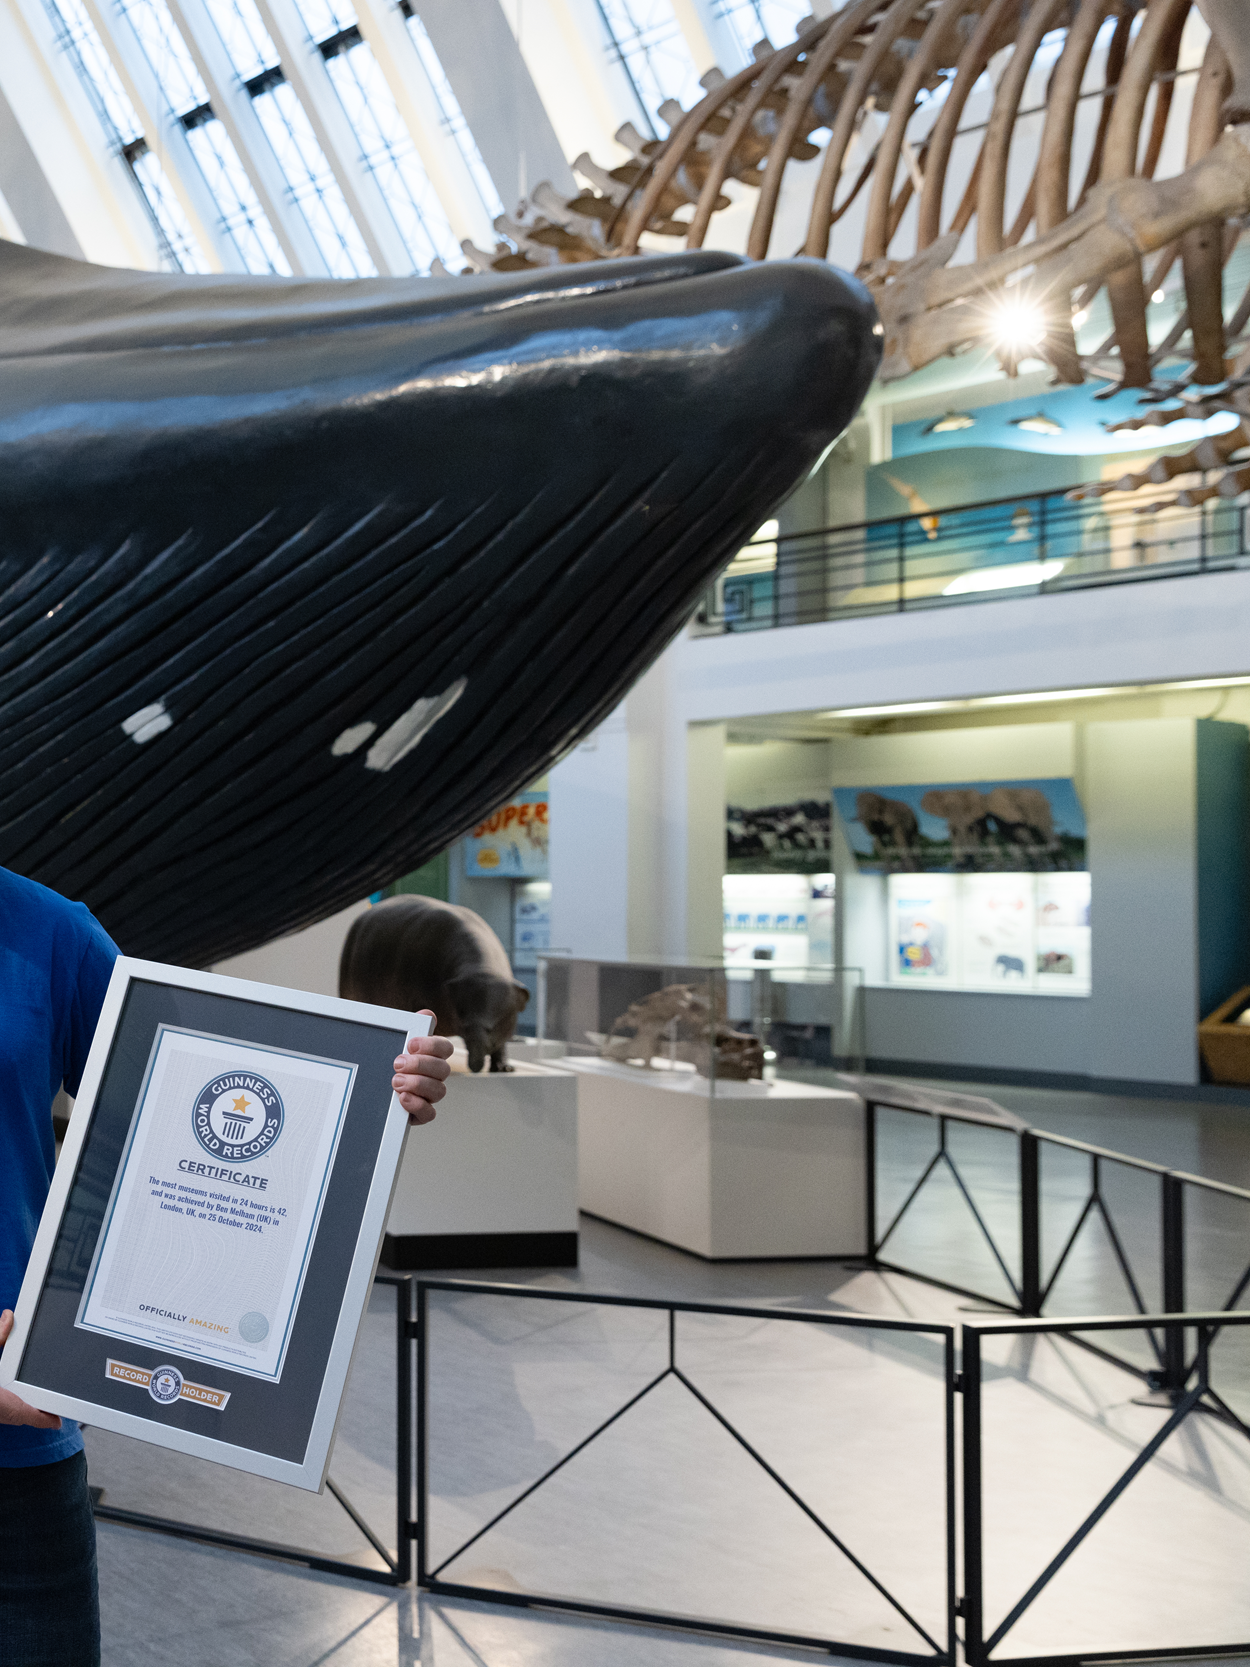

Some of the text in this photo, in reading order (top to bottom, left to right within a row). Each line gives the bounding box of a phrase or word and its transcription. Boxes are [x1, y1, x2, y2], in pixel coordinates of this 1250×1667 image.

[211, 1076, 276, 1106] GUINNESS
[197, 1104, 278, 1157] WORLD RECORDS
[178, 1159, 269, 1189] CERTIFICATE
[149, 1175, 160, 1186] The
[161, 1180, 177, 1190] most
[178, 1184, 208, 1197] museums
[209, 1191, 231, 1203] visited
[231, 1196, 239, 1205] in
[239, 1197, 249, 1207] 24
[249, 1200, 268, 1212] hours
[269, 1205, 276, 1214] is
[150, 1189, 164, 1198] and
[164, 1192, 176, 1201] was
[177, 1195, 206, 1208] achieved
[206, 1201, 215, 1211] by
[215, 1203, 229, 1214] Ben
[256, 1213, 272, 1226] (UK)
[272, 1217, 280, 1227] in
[160, 1201, 264, 1234] London, UK, on 25 October 2024.
[138, 1303, 229, 1334] OFFICIALLY AMAZING
[113, 1366, 149, 1383] RECORD
[156, 1369, 179, 1382] GUINNESS
[160, 1385, 180, 1400] RECORDS
[182, 1386, 220, 1403] HOLDER
